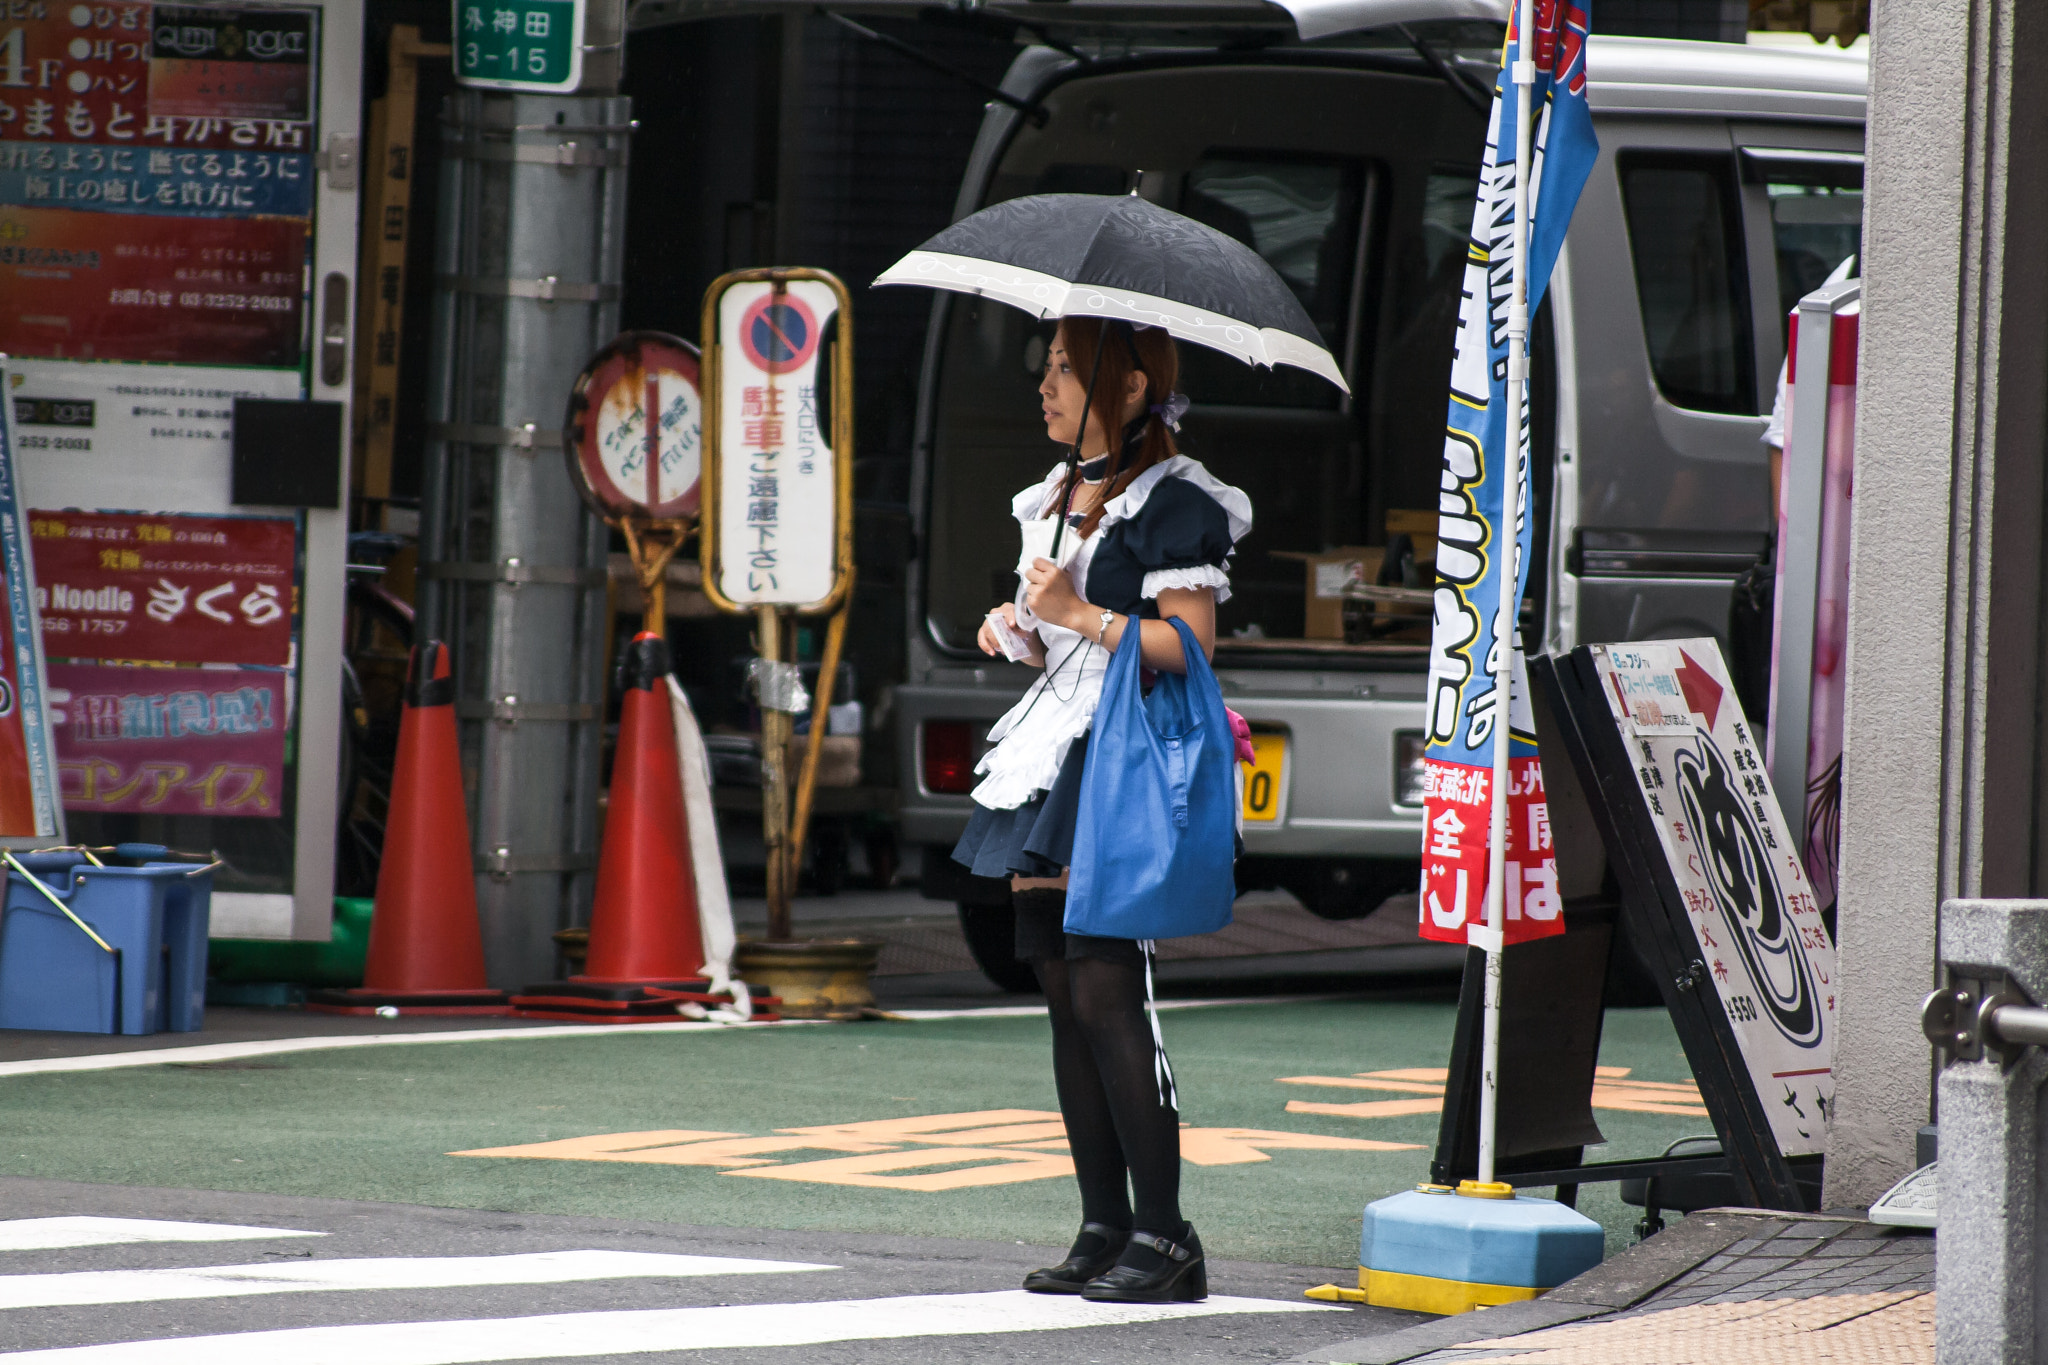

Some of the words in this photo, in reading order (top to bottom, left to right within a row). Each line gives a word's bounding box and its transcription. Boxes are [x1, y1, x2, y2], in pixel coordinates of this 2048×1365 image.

[465, 7, 551, 37] 外神田
[94, 40, 152, 63] 耳つ
[464, 42, 547, 75] 3-15
[797, 384, 816, 475] 出入口につき
[741, 386, 785, 592] 駐車ご遠慮下さい
[53, 584, 134, 613] Noodle
[146, 578, 284, 625] さくら
[1673, 820, 1715, 913] まぐろ
[1787, 854, 1827, 949] うなぎ
[1685, 888, 1728, 984] 鉄火丼
[1725, 995, 1758, 1034] ¥550
